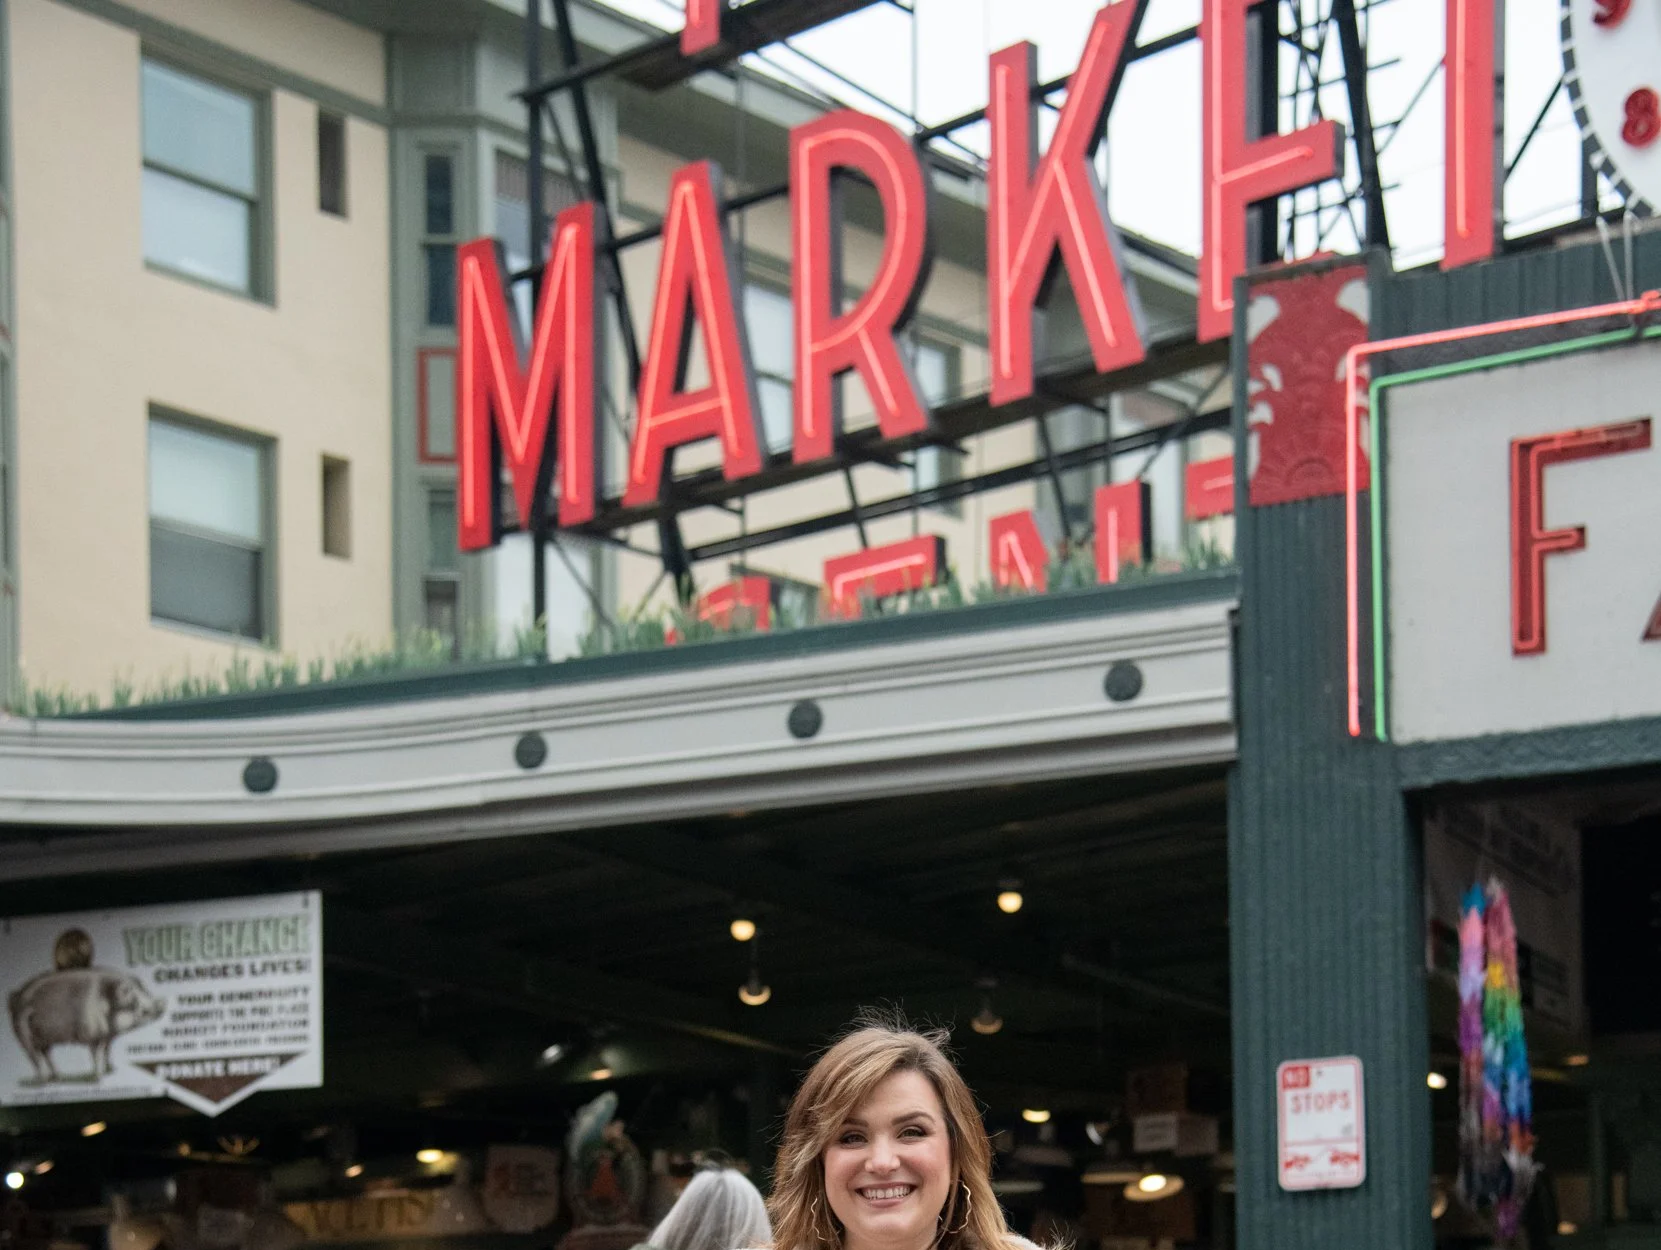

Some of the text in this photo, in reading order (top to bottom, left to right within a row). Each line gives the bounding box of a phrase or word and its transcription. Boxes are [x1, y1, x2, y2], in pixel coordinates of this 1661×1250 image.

[1510, 416, 1661, 655] F
[123, 912, 311, 967] YOUR CHANGE
[154, 962, 245, 983] CHANGES
